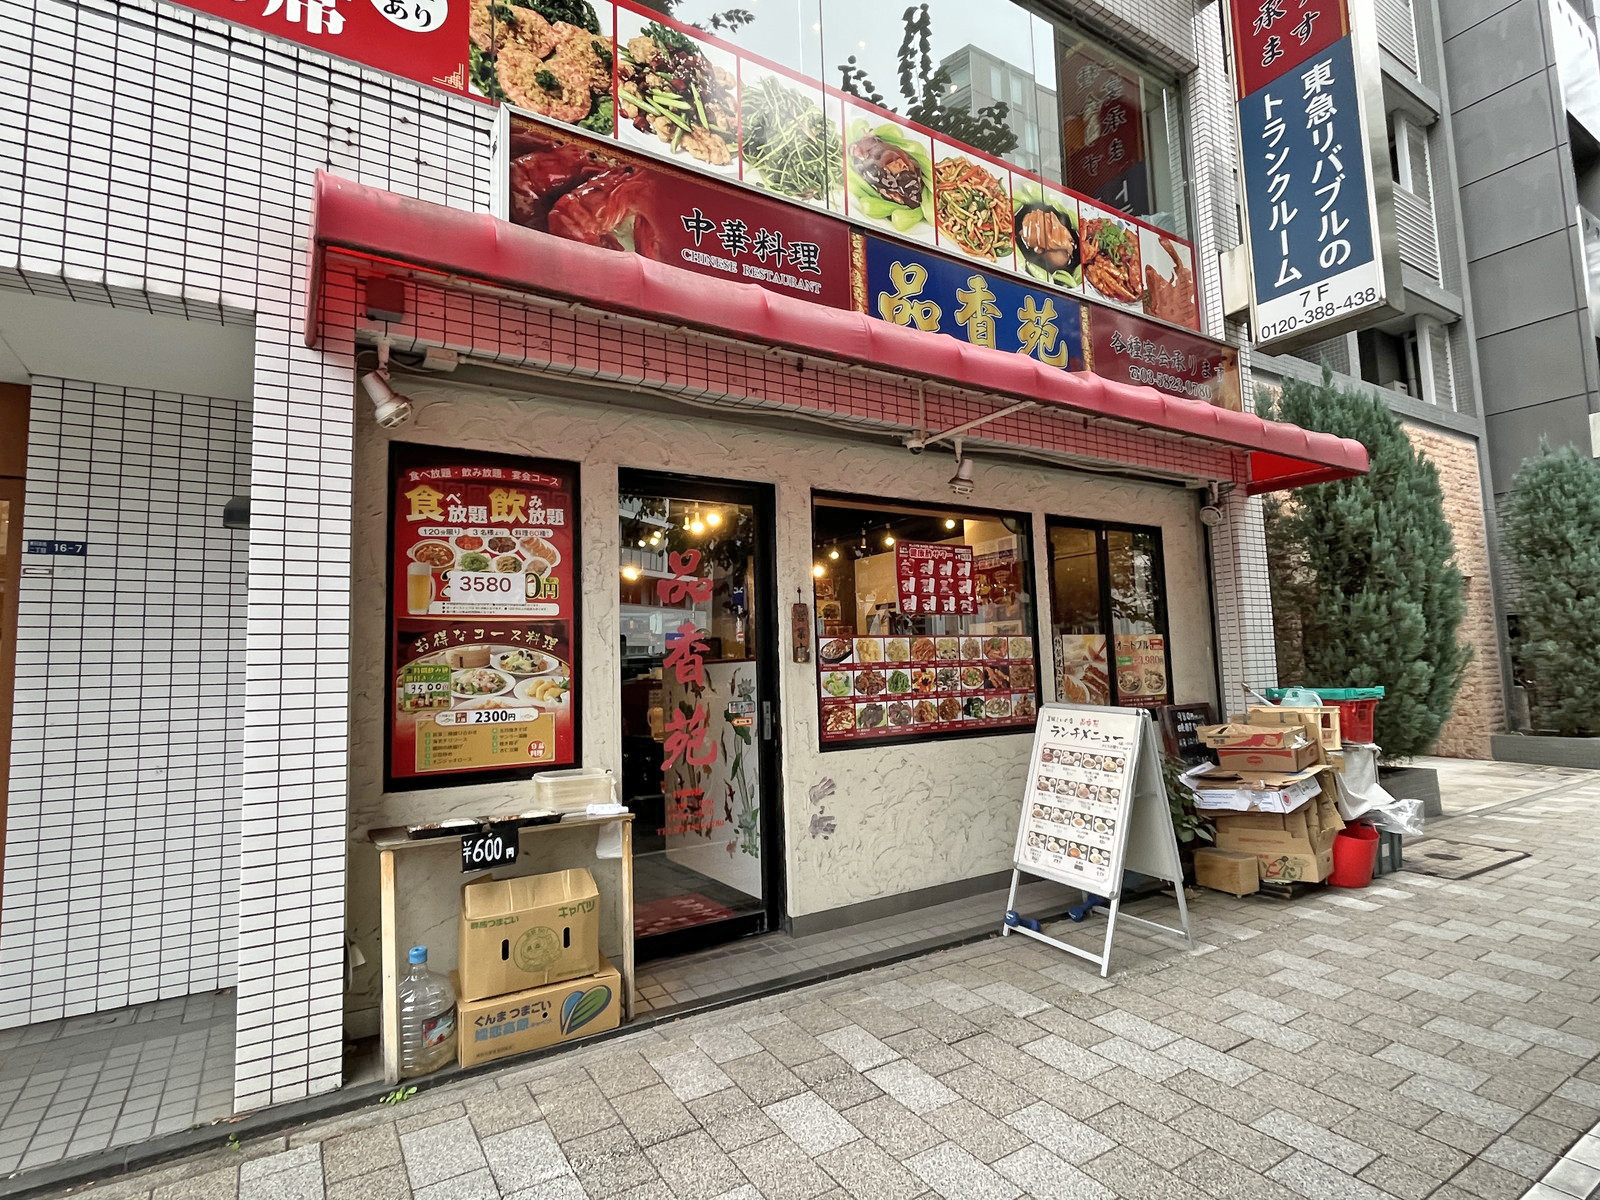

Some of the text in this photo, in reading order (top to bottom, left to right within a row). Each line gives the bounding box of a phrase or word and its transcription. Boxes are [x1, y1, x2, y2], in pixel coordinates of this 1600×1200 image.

[1301, 58, 1351, 269] 東急リバブルの
[1262, 93, 1303, 289] トランクルーム
[680, 207, 822, 275] 中華料理
[681, 248, 822, 294] CHINESE RESTAURANT
[878, 261, 1068, 369] 品香苑
[1261, 287, 1376, 339] 0120-388-438
[1110, 330, 1226, 383] 各種宴会承ります
[1140, 367, 1213, 399] 03-5823-0780
[54, 543, 83, 553] 16-7
[459, 576, 512, 593] 3580
[415, 628, 560, 653] お得なコース料理
[657, 548, 718, 772] 品香苑
[475, 710, 516, 723] 2300円
[1050, 725, 1125, 744] ランチメニュー
[474, 1011, 507, 1027] ぐんま
